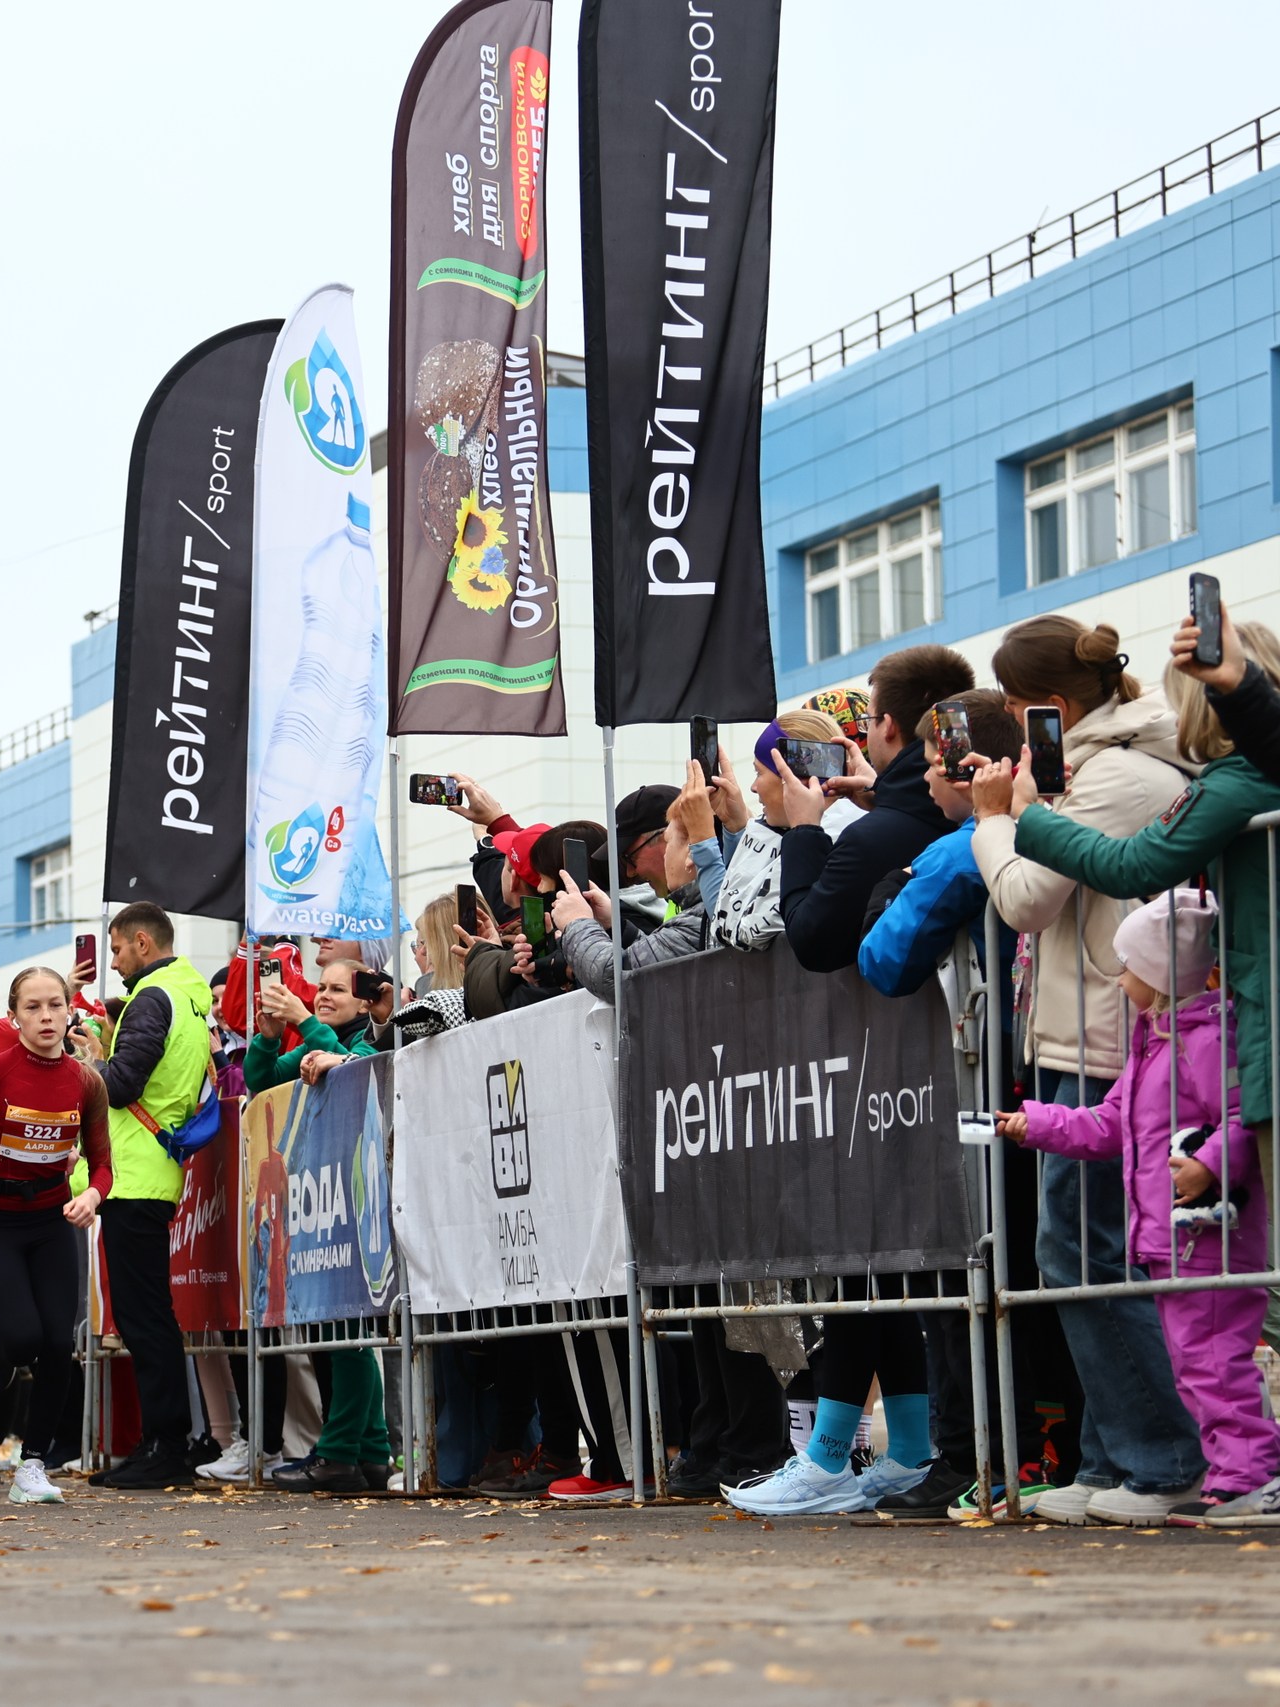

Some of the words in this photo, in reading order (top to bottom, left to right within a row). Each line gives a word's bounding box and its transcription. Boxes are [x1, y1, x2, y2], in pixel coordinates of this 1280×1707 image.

[688, 0, 722, 112] spor
[479, 44, 501, 166] спорта
[514, 61, 531, 239] СОРМОВСКИЙ
[446, 152, 472, 237] хлеб
[481, 184, 502, 247] для
[645, 152, 717, 596] рейтинг
[207, 425, 235, 514] sport
[155, 535, 219, 835] рейтинг
[275, 907, 386, 933] waterya.ru
[24, 1124, 62, 1140] 5224
[24, 1142, 55, 1151] ДАРЬЯ
[655, 1044, 849, 1193] рейтинг
[867, 1075, 934, 1142] sport
[288, 1162, 348, 1243] ВОДА
[498, 1209, 538, 1249] АМБА
[826, 1447, 846, 1459] ТАМ
